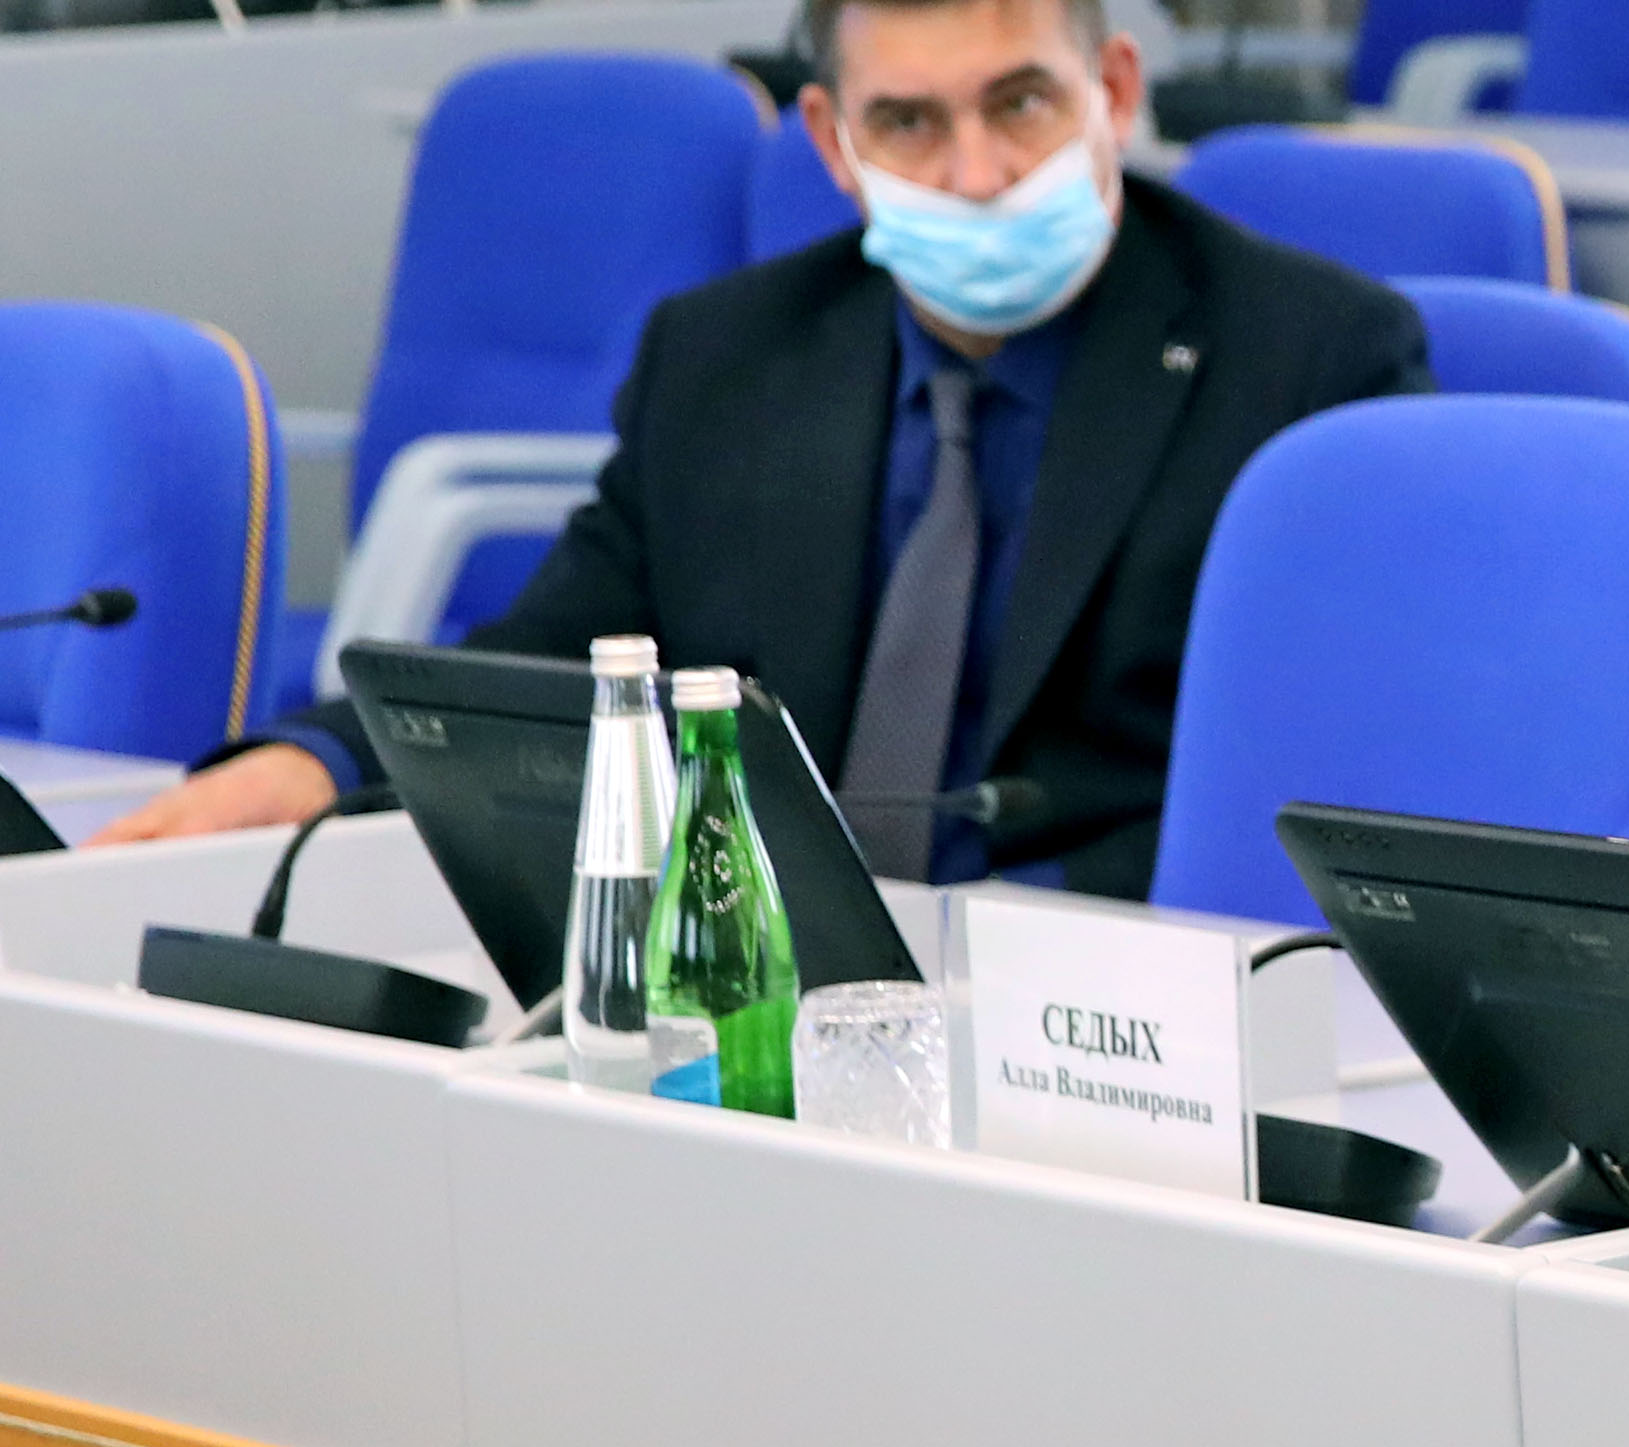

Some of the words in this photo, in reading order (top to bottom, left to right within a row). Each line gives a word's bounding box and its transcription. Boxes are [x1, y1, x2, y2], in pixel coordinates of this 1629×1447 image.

[1043, 1003, 1162, 1063] СЕДЫХ
[1000, 1058, 1049, 1092] Алла
[1056, 1066, 1213, 1124] Владимировна
